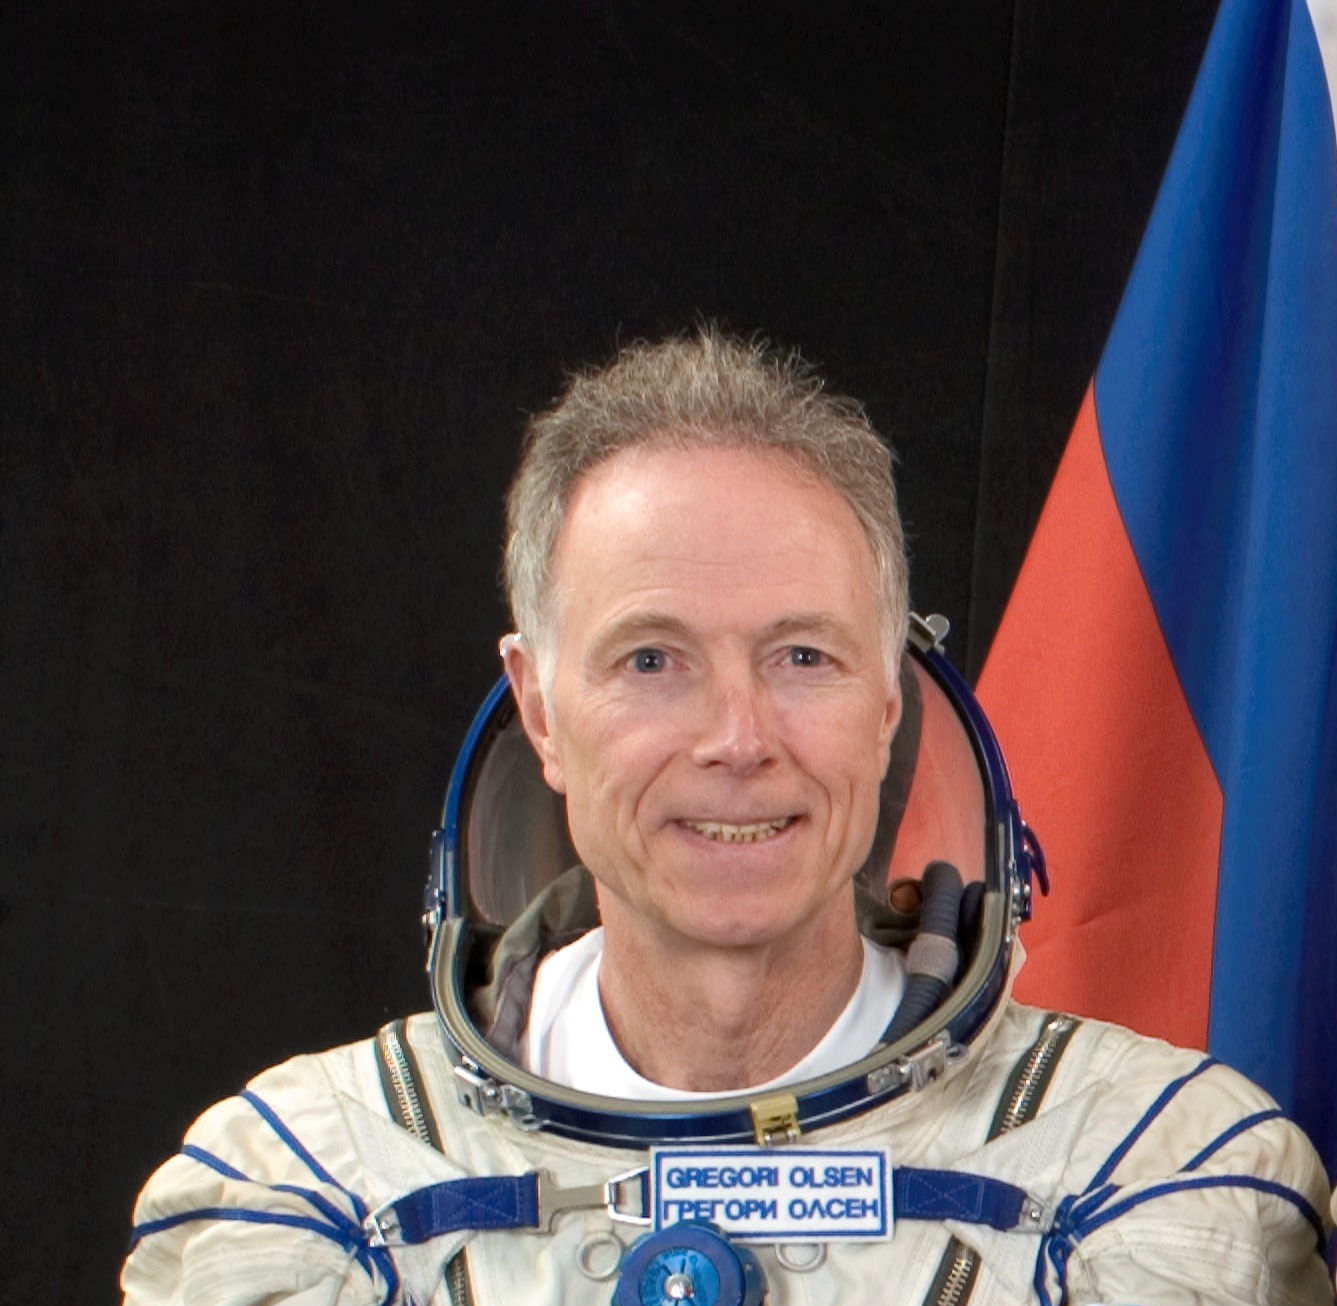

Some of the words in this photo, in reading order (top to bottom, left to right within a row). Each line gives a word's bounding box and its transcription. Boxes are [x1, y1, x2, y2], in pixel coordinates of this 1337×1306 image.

[666, 1166, 780, 1189] GREGORI
[788, 1166, 874, 1189] OLSEN
[662, 1199, 778, 1220] ГРЕГОРИ
[788, 1199, 880, 1220] ОЛСЕН
